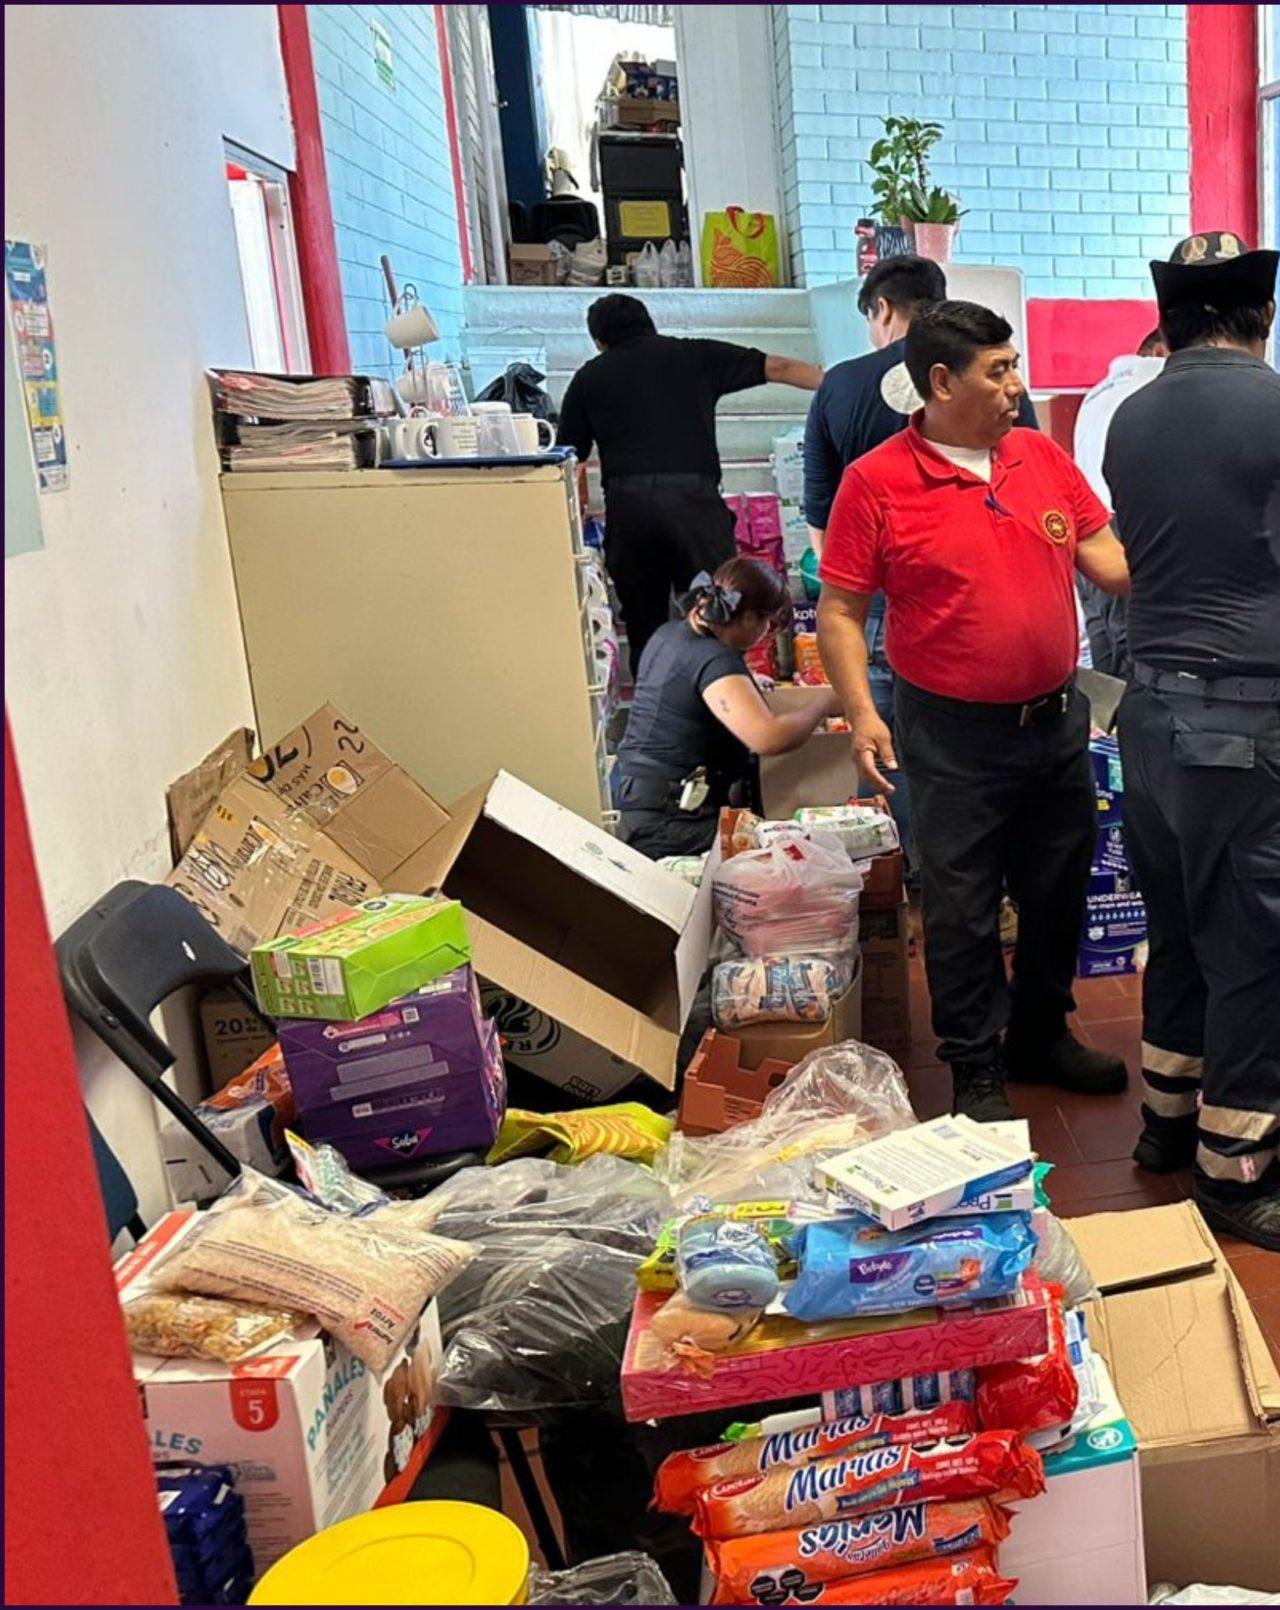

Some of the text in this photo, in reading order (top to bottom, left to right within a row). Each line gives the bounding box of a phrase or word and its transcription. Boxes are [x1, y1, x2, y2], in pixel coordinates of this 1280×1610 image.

[793, 605, 817, 620] kot
[1086, 891, 1142, 904] UNDERWEA
[391, 1132, 419, 1149] Saba
[250, 1399, 265, 1425] 5
[307, 1357, 367, 1451] PAÑALES
